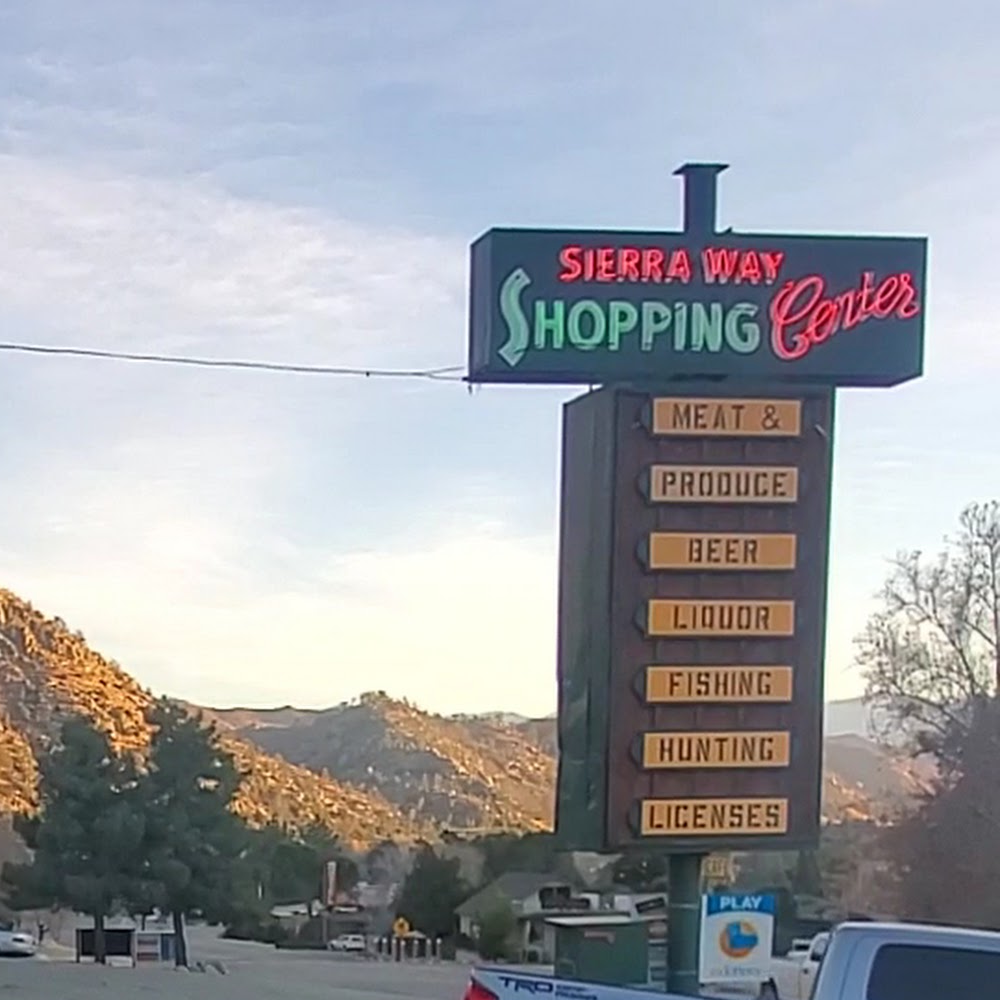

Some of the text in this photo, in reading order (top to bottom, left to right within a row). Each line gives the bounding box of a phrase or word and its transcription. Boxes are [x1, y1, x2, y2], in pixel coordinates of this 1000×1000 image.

[558, 246, 784, 284] SIERRA WAY
[498, 268, 761, 366] SHOPPING
[769, 271, 919, 360] Center
[672, 404, 780, 430] MEAT &
[661, 471, 788, 497] PRODUCE
[688, 538, 758, 563] BEER
[673, 605, 770, 630] LIQUOR
[669, 672, 772, 696] FISHING
[659, 737, 774, 762] HUNTING
[649, 804, 780, 829] LICENSES
[719, 896, 762, 910] PLAY
